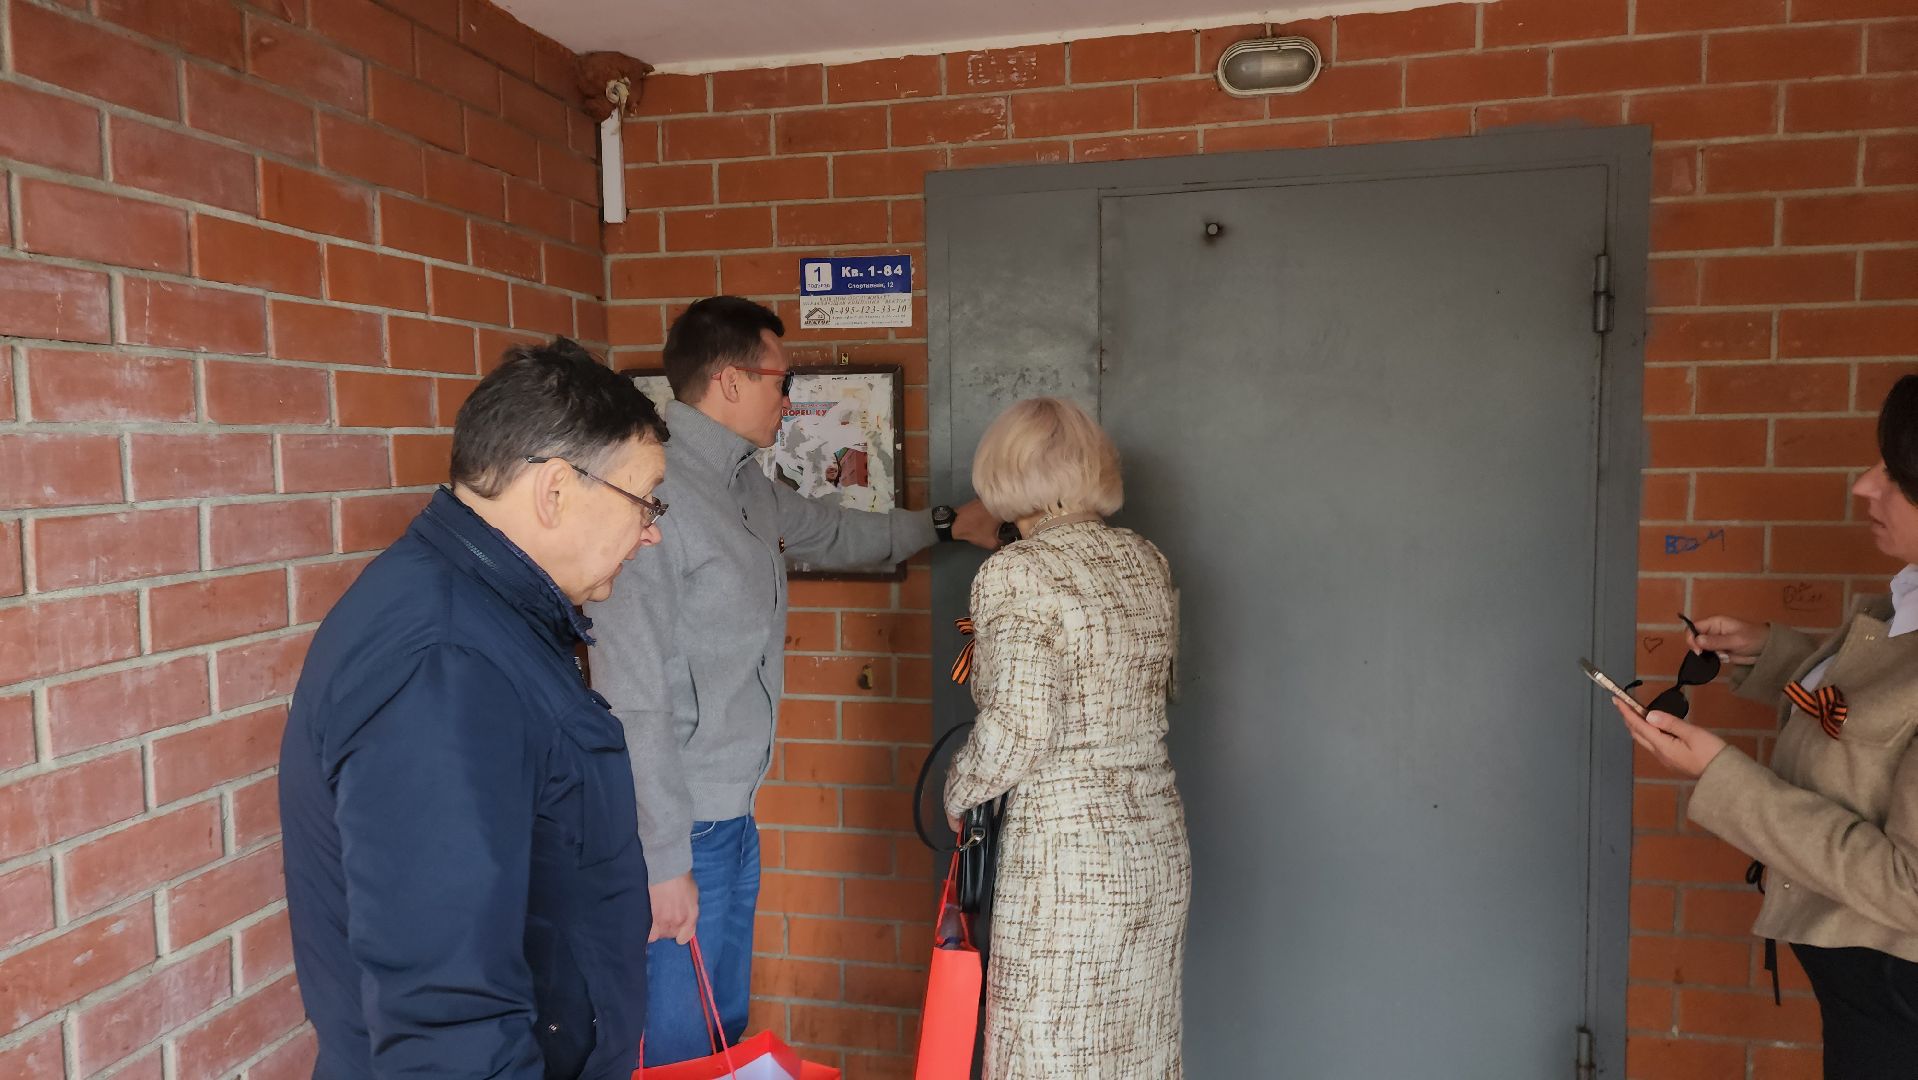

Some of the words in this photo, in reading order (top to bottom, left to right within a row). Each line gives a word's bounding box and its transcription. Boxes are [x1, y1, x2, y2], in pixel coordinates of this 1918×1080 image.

[814, 266, 821, 282] 1
[841, 266, 864, 278] Кв.
[867, 264, 903, 277] 1-84
[829, 305, 907, 315] 8-495-123-33-10
